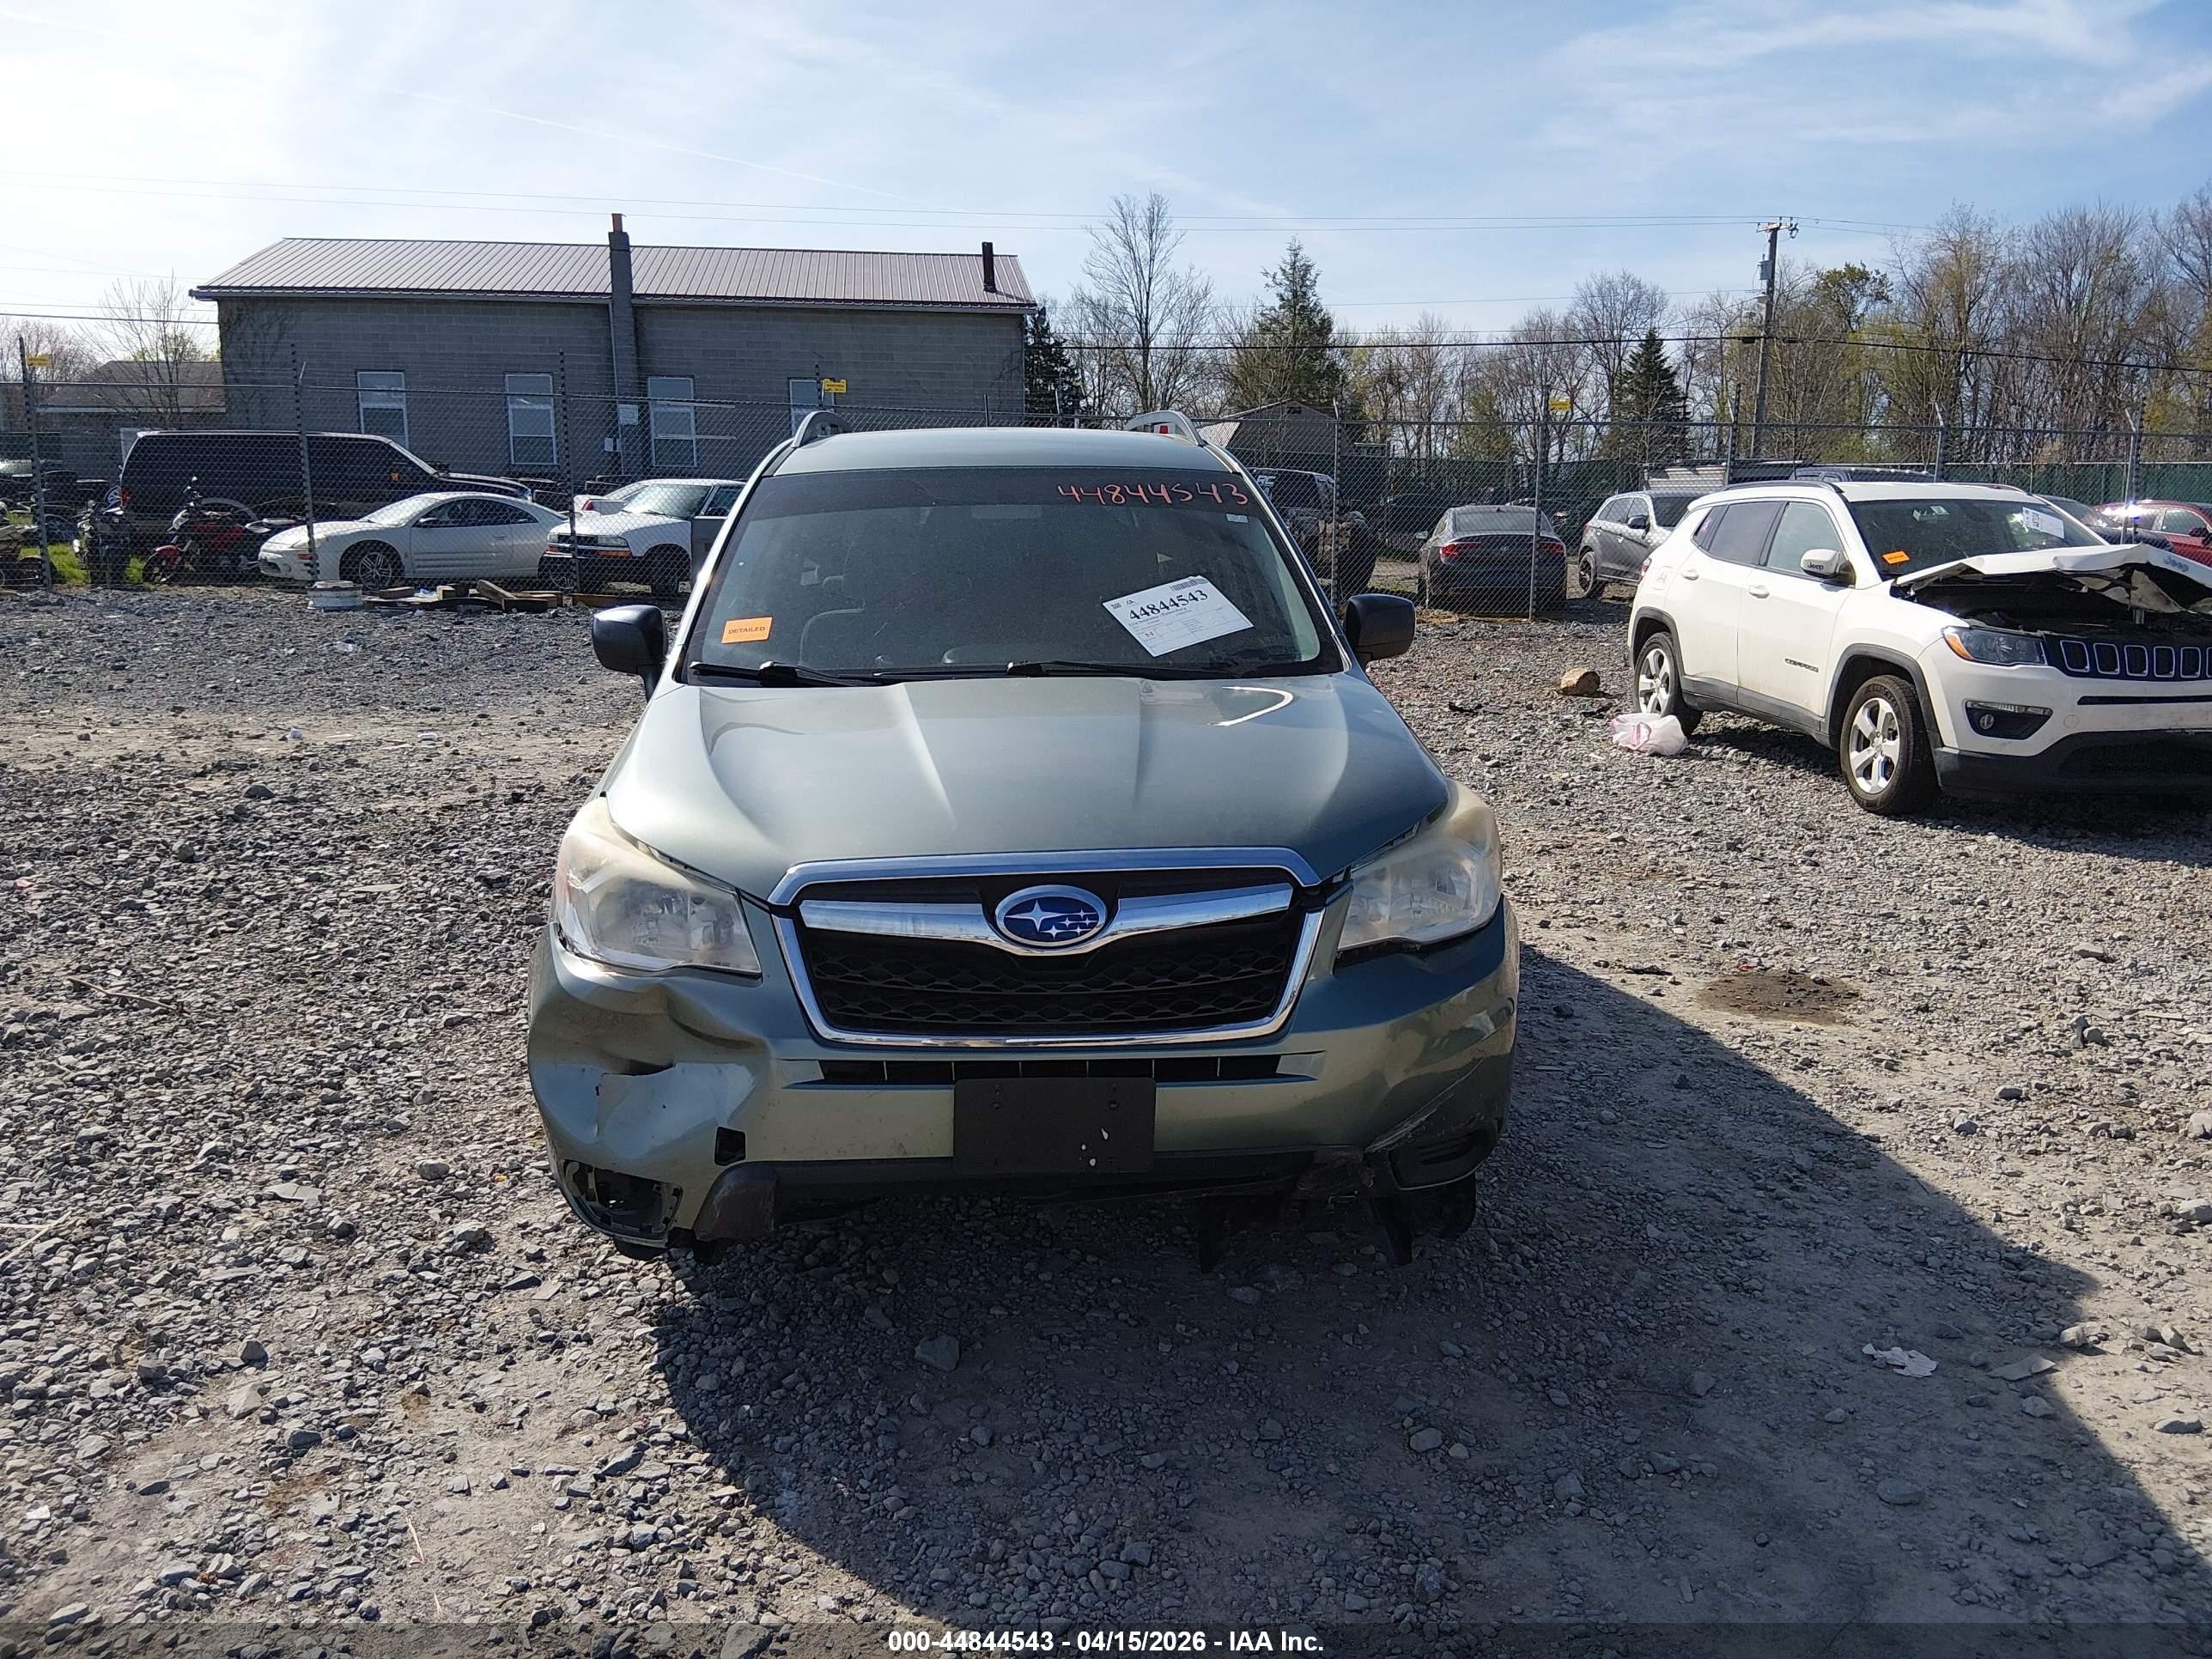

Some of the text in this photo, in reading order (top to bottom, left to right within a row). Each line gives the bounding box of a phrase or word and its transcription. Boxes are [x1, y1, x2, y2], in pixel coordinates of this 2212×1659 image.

[1057, 482, 1249, 506] 44844543
[1807, 562, 1824, 571] Jeep
[2162, 555, 2190, 573] Jeep
[1129, 589, 1208, 621] 44844543
[727, 626, 766, 635] DETAILED
